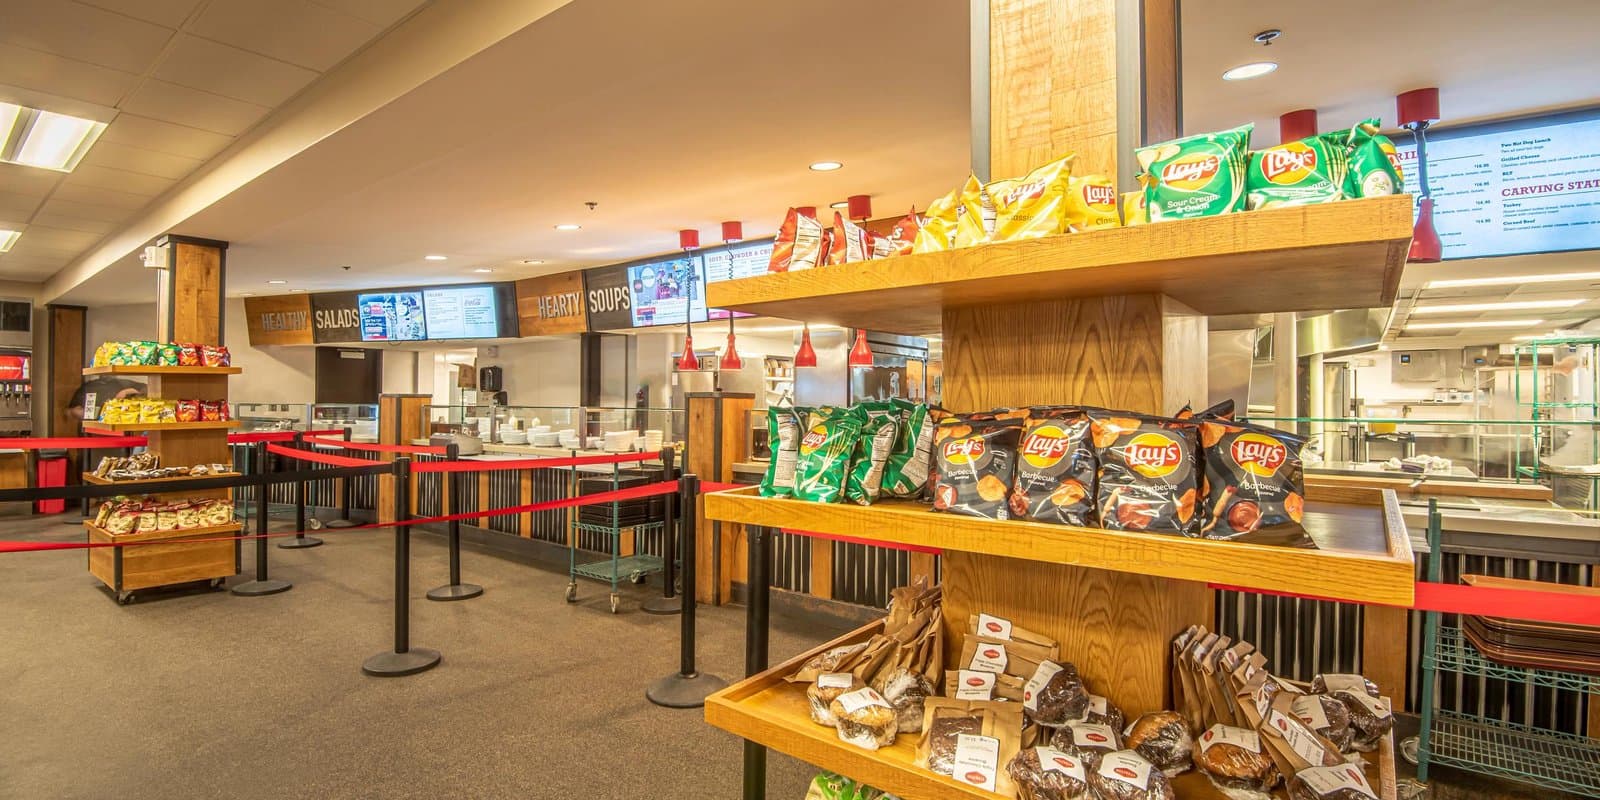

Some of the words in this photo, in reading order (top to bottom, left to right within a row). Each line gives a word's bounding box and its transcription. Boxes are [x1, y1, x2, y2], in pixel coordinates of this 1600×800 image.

[1163, 154, 1219, 181] Lay's
[1266, 147, 1315, 178] Lay's
[1502, 183, 1564, 197] CARVING
[1167, 200, 1188, 209] Sour
[537, 292, 581, 319] HEARTY
[589, 286, 631, 313] SOUPS
[261, 311, 307, 331] HEALTHY
[316, 308, 360, 329] SALADS
[1024, 434, 1069, 458] Lay's
[1130, 443, 1178, 468] Lay's
[1237, 441, 1283, 466] Lay's
[1022, 471, 1055, 482] Barbecue
